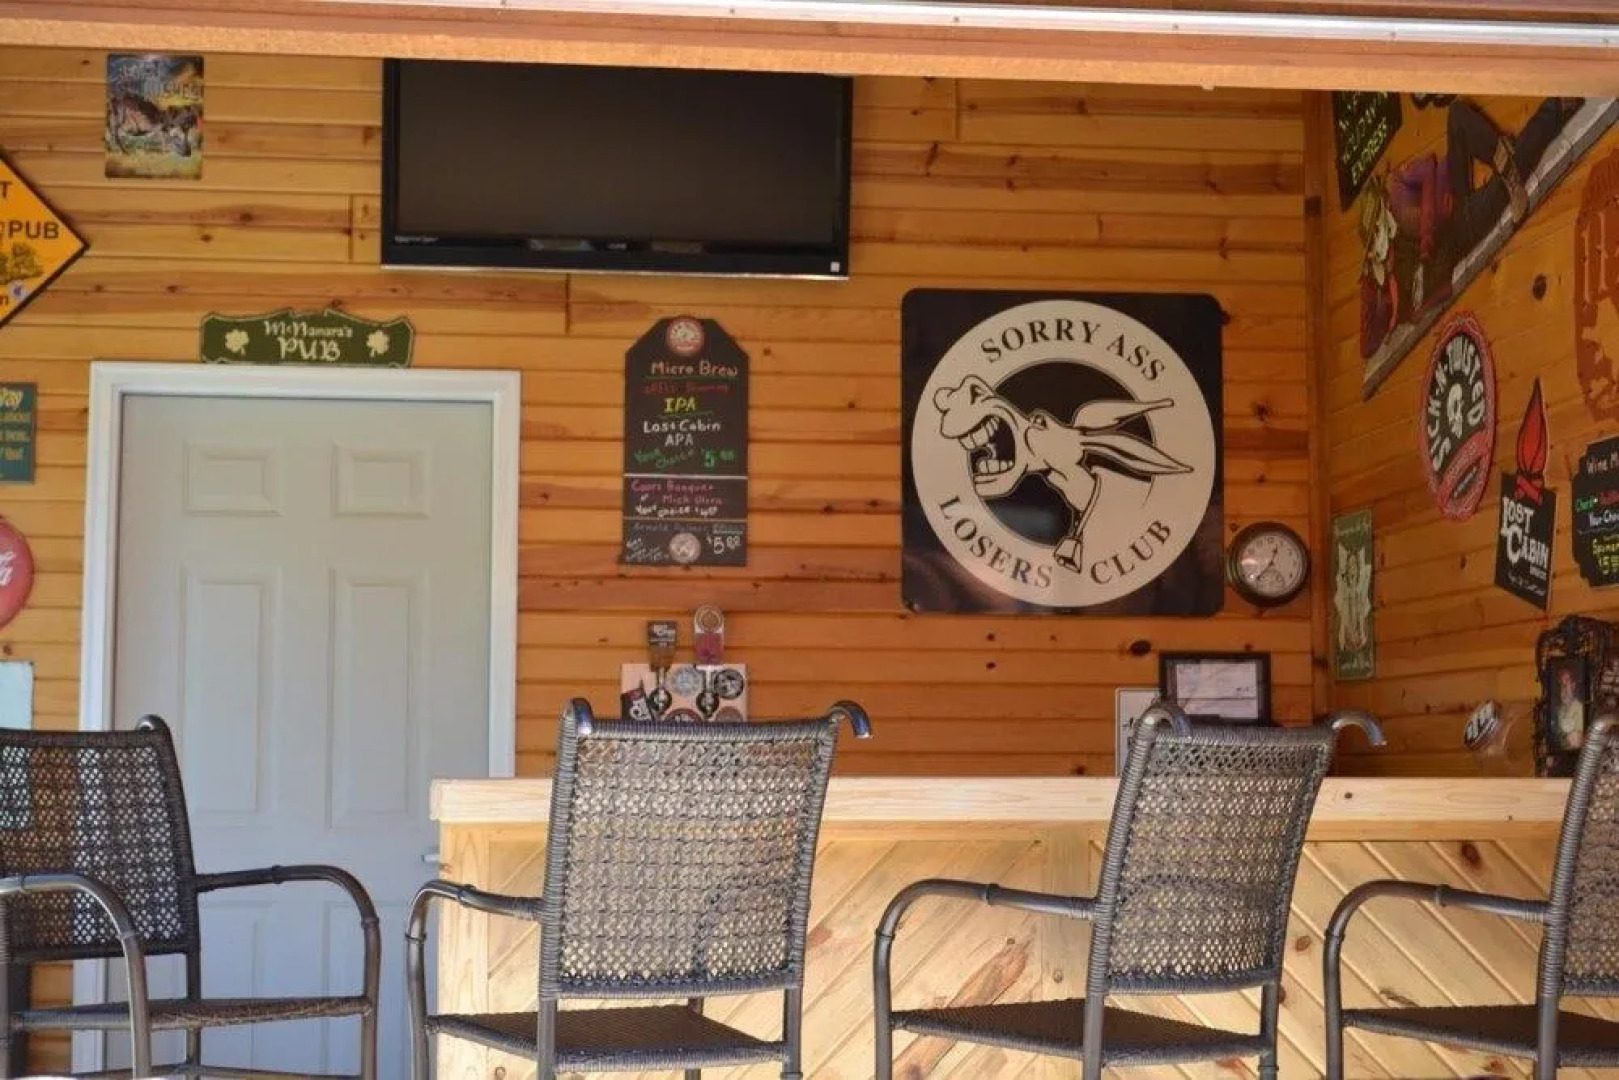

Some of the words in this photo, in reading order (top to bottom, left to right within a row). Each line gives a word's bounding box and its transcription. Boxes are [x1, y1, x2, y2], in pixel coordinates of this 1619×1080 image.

[9, 221, 59, 239] PUB
[278, 337, 341, 361] PUB
[980, 318, 1101, 363] SORRY
[1106, 332, 1166, 381] ASS
[651, 362, 694, 376] Micro
[699, 361, 738, 376] Brew
[664, 397, 697, 414] IPA
[643, 420, 676, 433] Lost
[679, 419, 721, 432] Cabin
[664, 433, 694, 448] APA
[1501, 496, 1534, 536] LOST
[939, 495, 1053, 589] LOSERS
[1090, 519, 1172, 585] CLUB
[1507, 524, 1550, 568] CABIN
